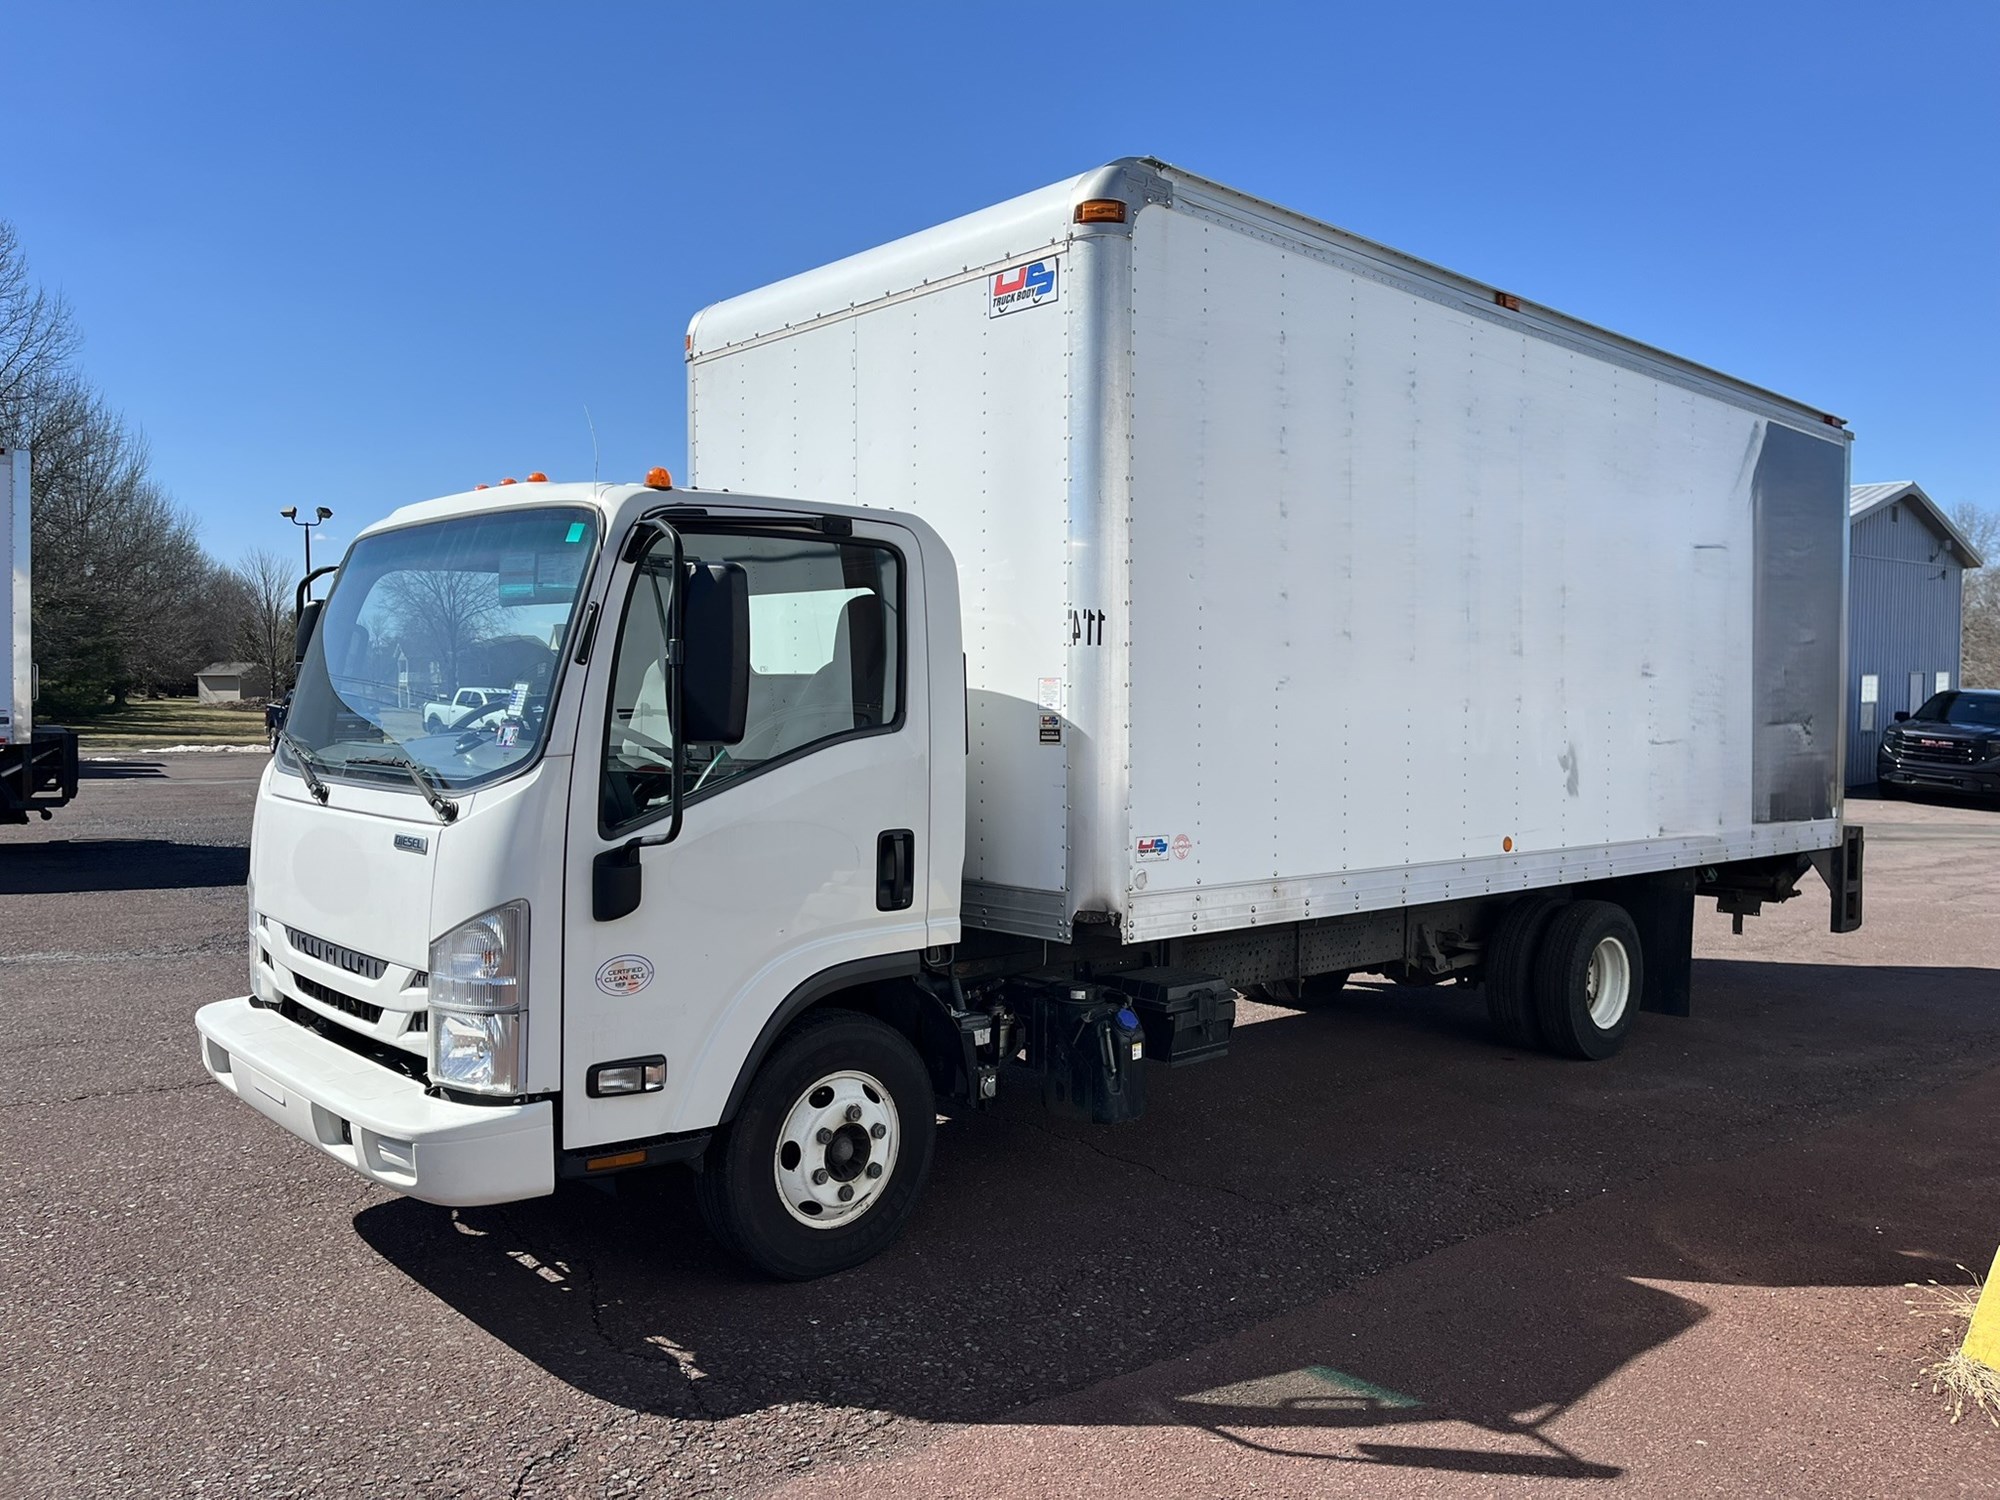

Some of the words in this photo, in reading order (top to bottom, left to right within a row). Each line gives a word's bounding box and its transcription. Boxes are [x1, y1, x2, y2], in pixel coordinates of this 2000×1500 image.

[994, 262, 1055, 296] US
[993, 292, 1016, 307] TRUCK
[1016, 287, 1036, 301] BODY
[395, 835, 421, 849] DIESEL
[1138, 839, 1168, 852] US
[608, 967, 643, 976] CERTIFIED
